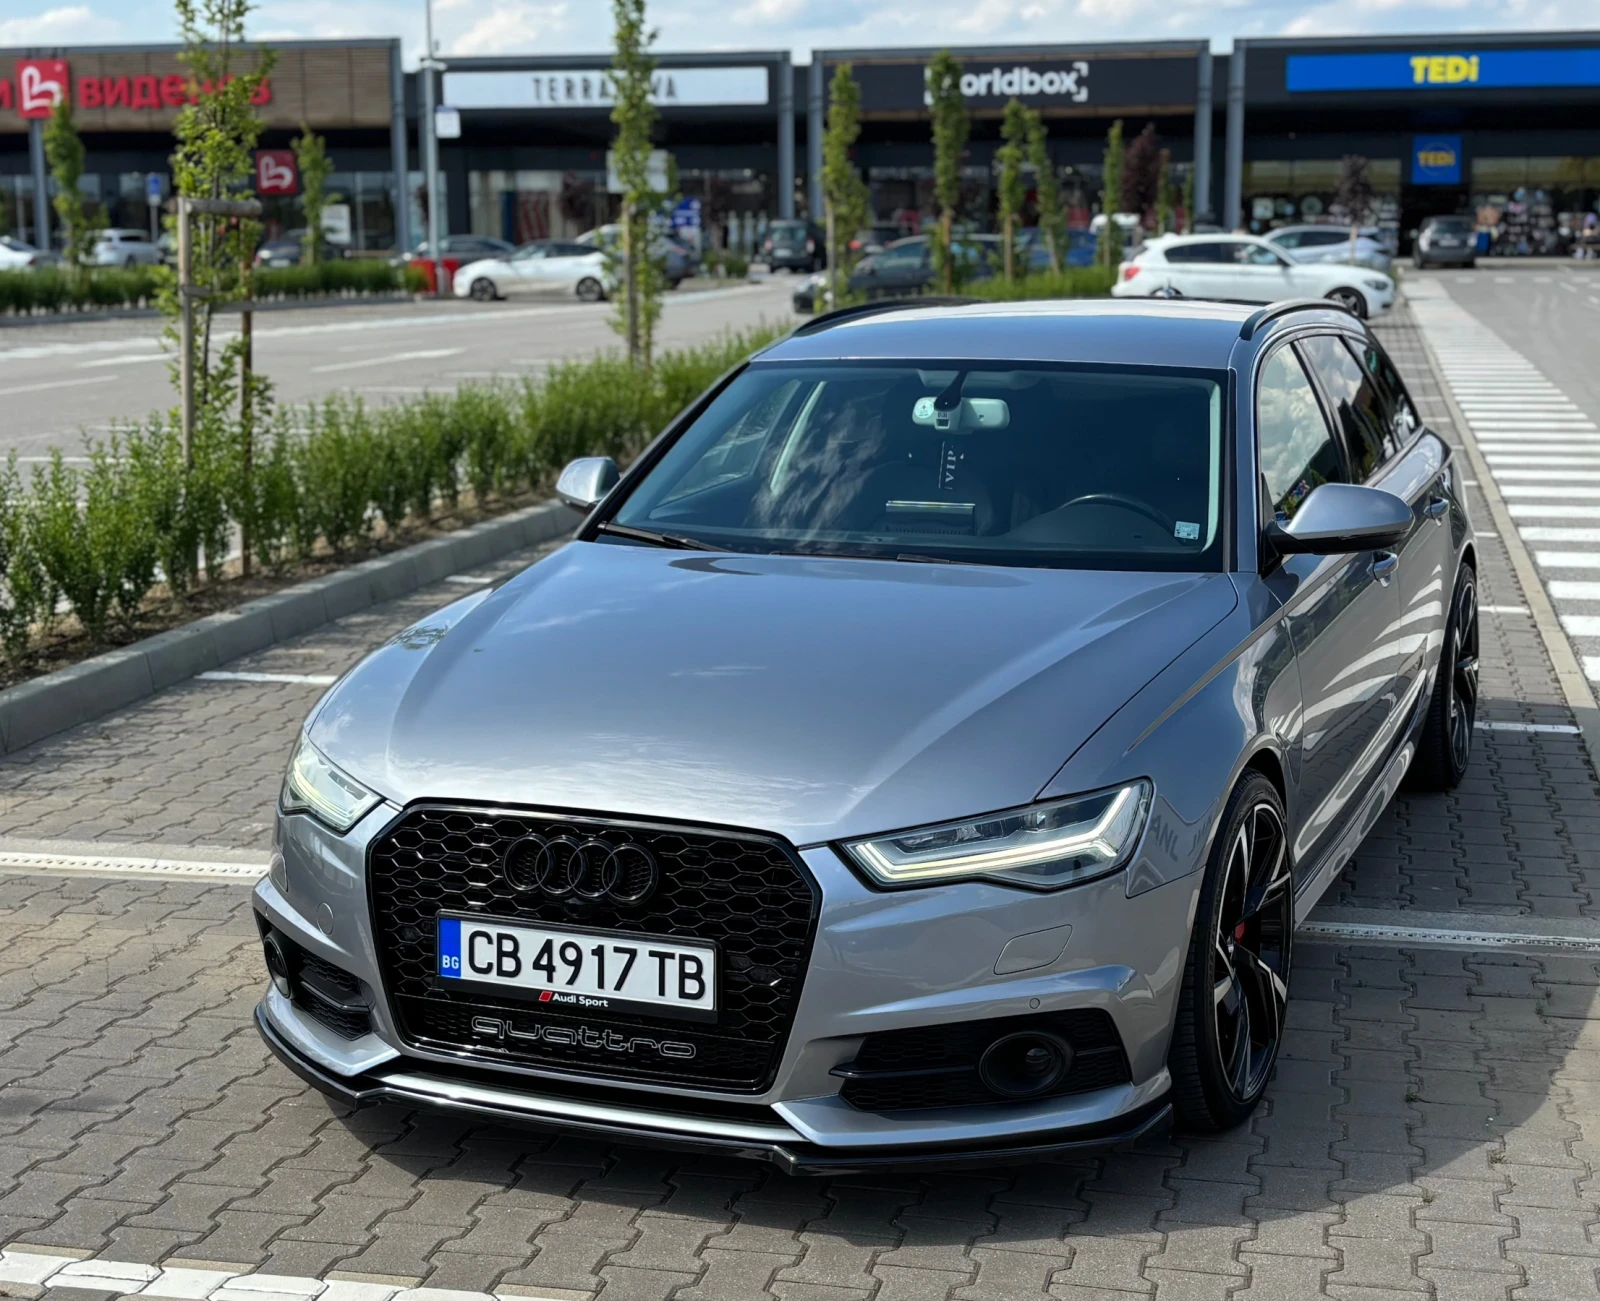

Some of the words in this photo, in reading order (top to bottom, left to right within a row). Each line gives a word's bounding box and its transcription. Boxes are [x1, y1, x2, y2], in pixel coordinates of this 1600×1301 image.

[941, 66, 1079, 97] orldbox
[1409, 55, 1480, 84] TEDi
[532, 76, 677, 101] TERRAVA
[442, 955, 460, 969] BG
[468, 930, 522, 978] CB
[532, 938, 638, 992] 4917
[648, 950, 706, 1001] TB
[552, 993, 576, 1004] Audi
[578, 996, 609, 1008] Sport
[471, 1016, 697, 1059] quattro
